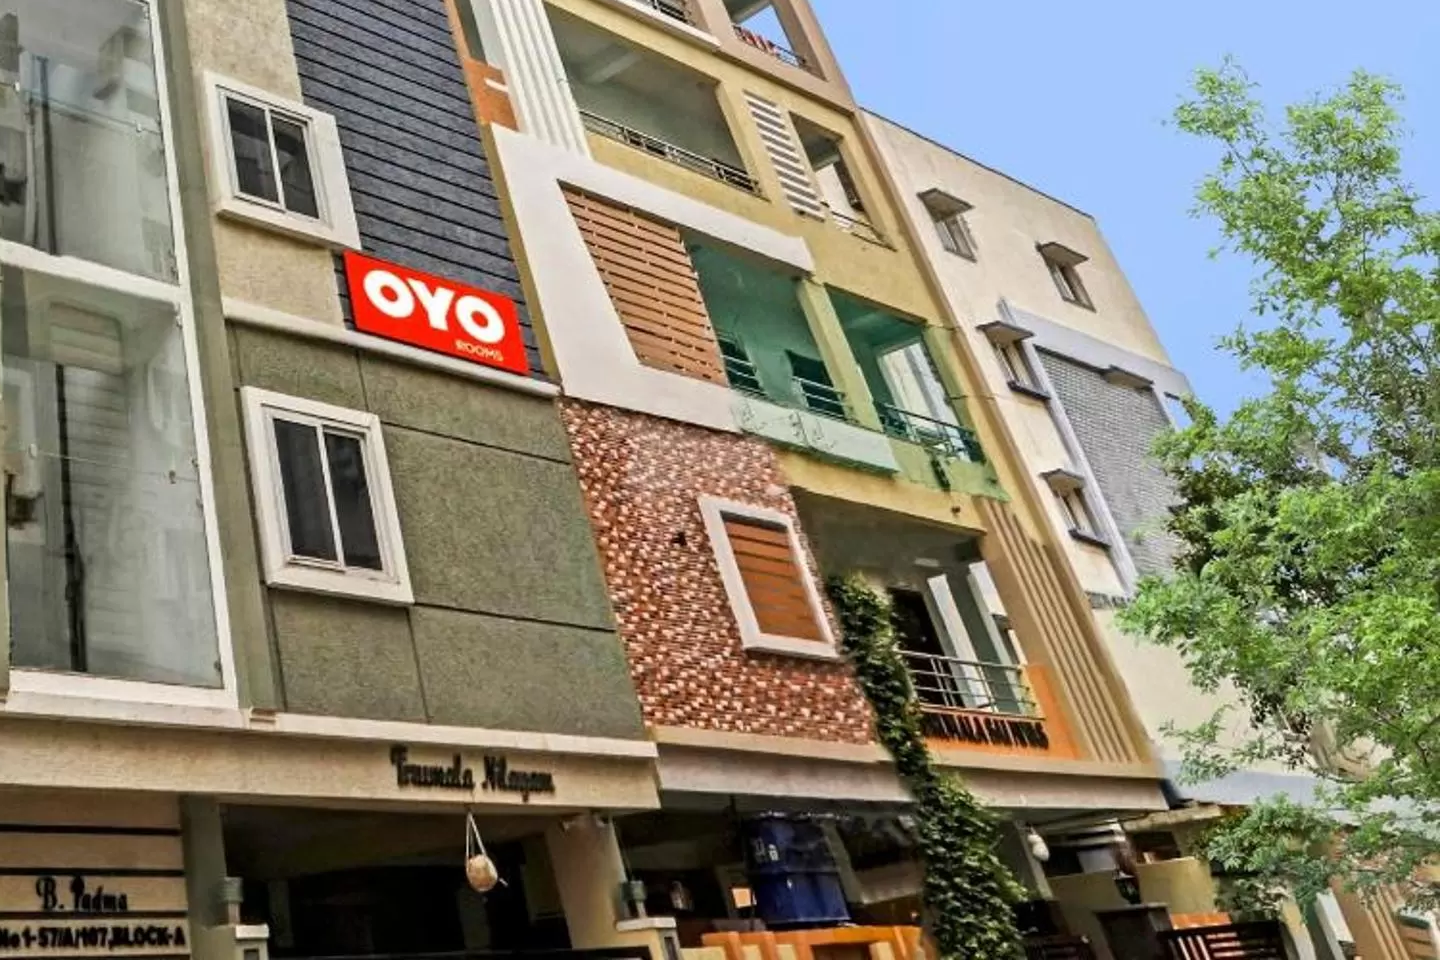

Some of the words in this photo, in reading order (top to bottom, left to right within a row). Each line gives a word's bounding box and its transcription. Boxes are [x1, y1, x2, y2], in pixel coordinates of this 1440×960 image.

[363, 269, 505, 344] OYO
[455, 339, 504, 362] ROOMS
[70, 874, 128, 911] Padma
